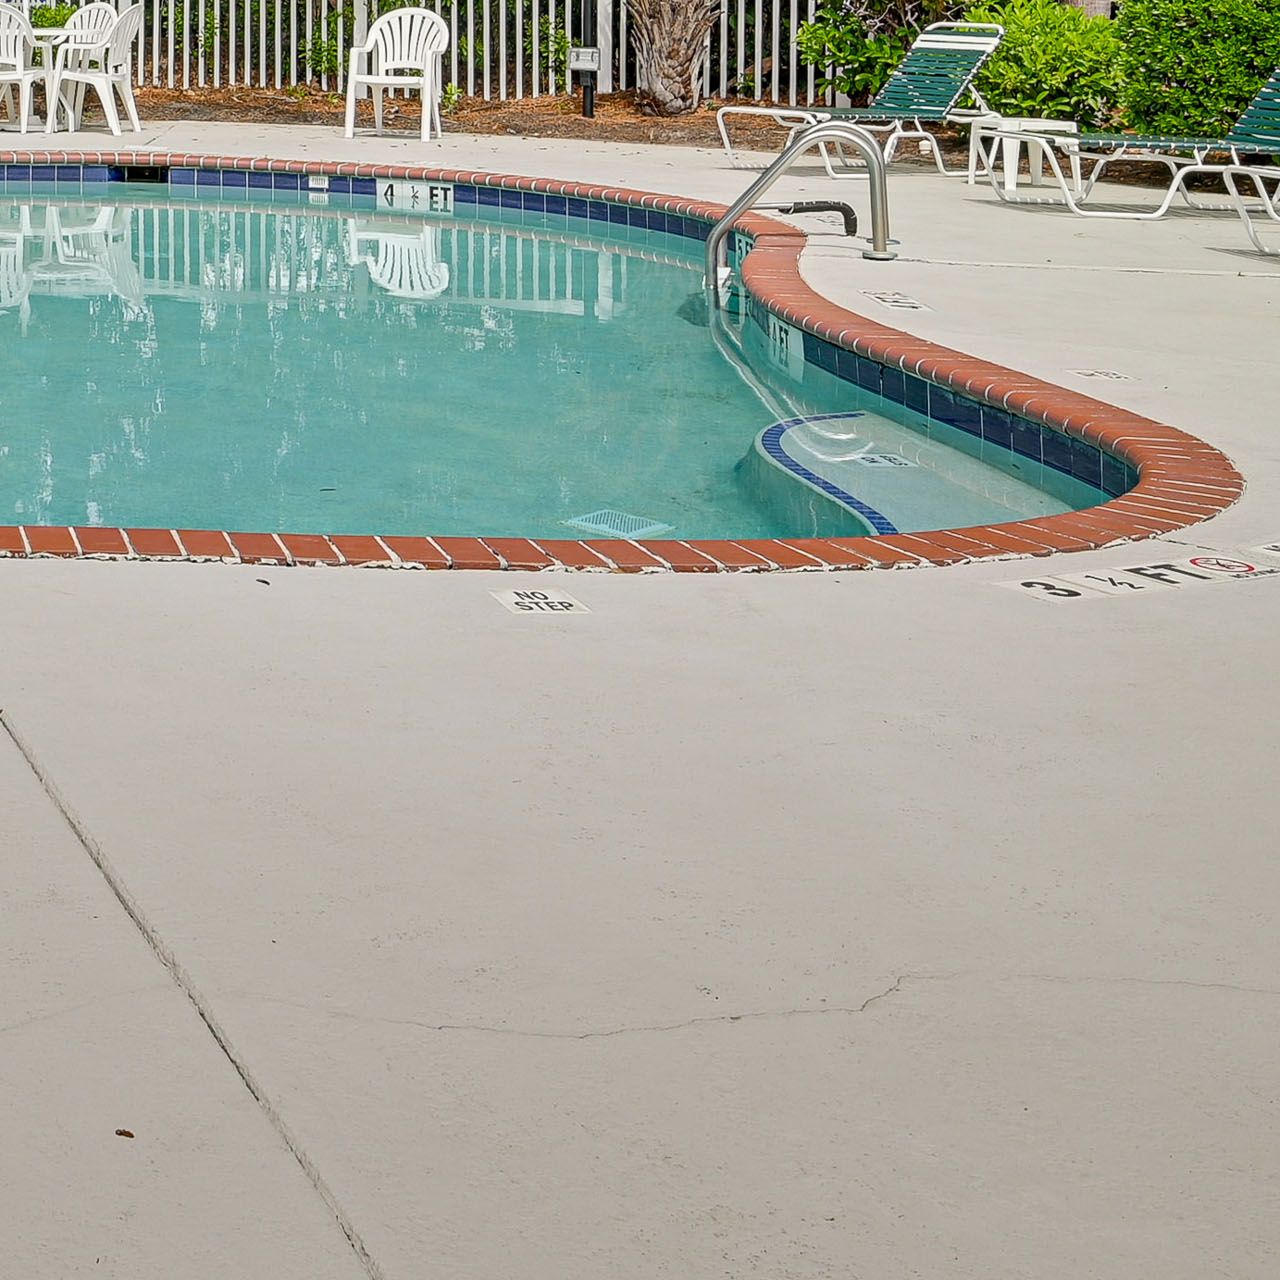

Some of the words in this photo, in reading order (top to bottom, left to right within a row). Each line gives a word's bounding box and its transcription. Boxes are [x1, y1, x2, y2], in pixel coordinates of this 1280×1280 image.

[1021, 581, 1082, 598] 3
[1122, 563, 1213, 584] FT
[513, 591, 549, 600] NO
[514, 601, 574, 611] STEP
